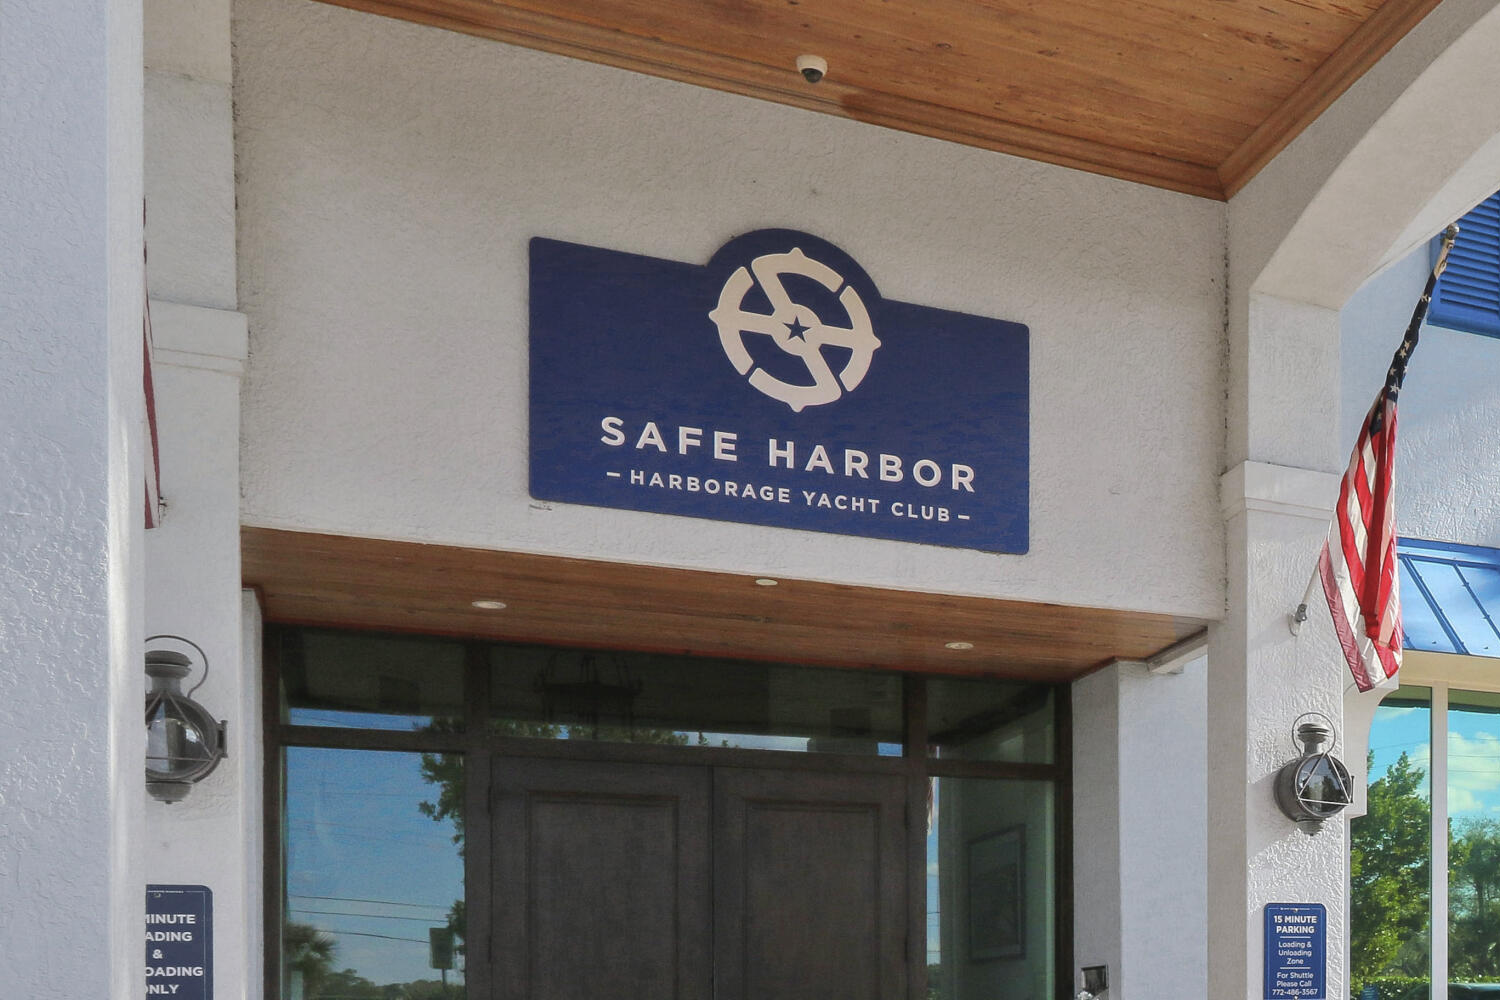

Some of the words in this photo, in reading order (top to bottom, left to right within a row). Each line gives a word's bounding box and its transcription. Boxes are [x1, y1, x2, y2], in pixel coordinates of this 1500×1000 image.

[600, 416, 738, 462] SAFE
[768, 438, 976, 493] HARBOR
[630, 469, 791, 504] HARBORAGE
[802, 490, 880, 514] YACHT
[890, 502, 951, 523] CLUB
[1274, 915, 1283, 923] 15
[1284, 915, 1317, 923] MINUTE
[1276, 925, 1315, 934] PARKING
[1278, 941, 1305, 949] Loading
[152, 949, 163, 959] &
[1278, 949, 1312, 958] Unloading
[1286, 957, 1304, 965] Zone
[1276, 971, 1289, 979] For
[1290, 971, 1314, 979] Shuttle
